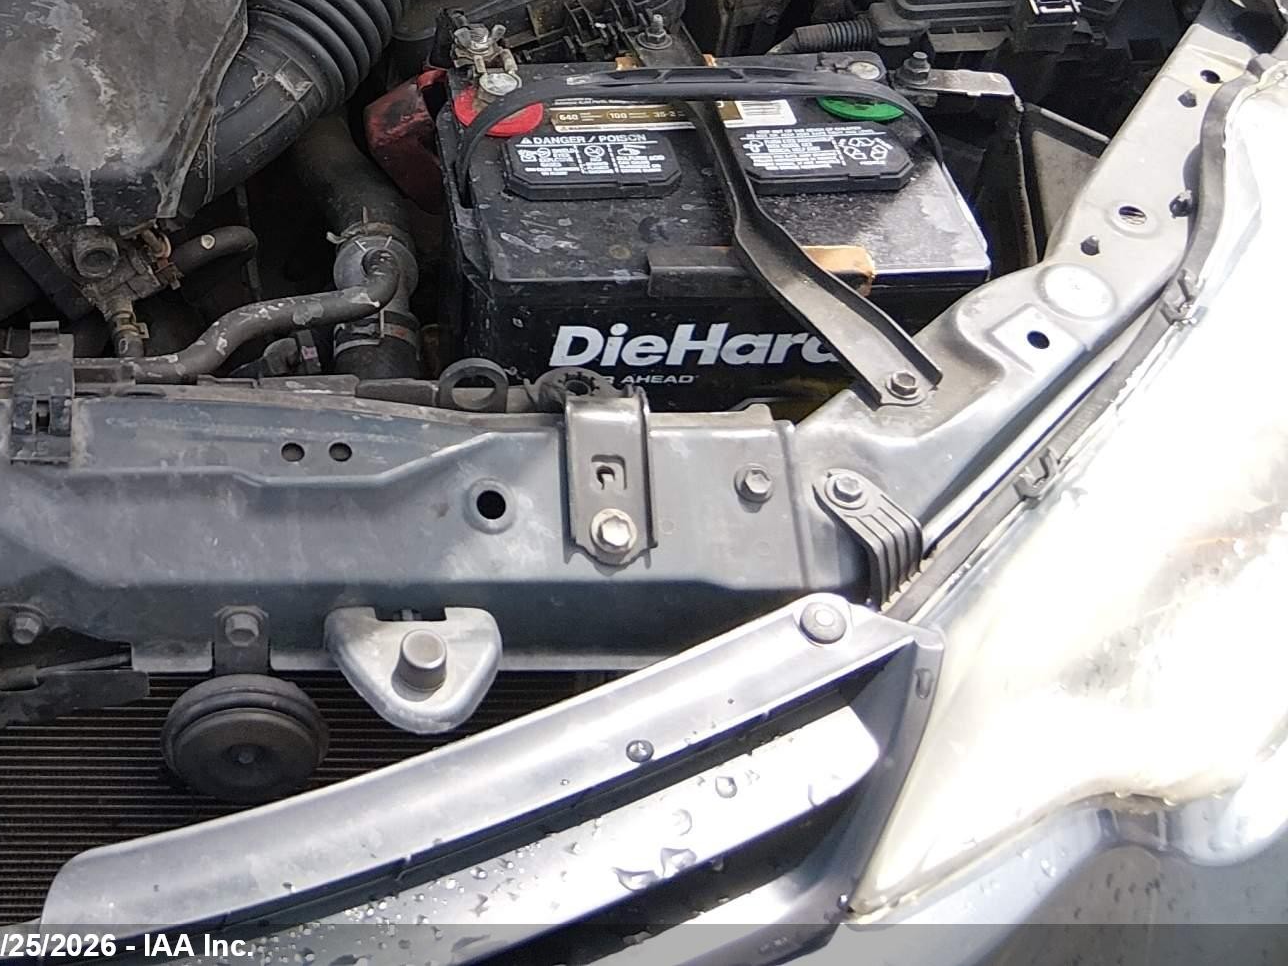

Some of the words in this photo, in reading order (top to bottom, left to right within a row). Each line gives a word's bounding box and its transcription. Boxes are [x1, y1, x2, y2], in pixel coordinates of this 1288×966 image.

[533, 136, 585, 144] DANGER
[599, 134, 647, 142] POISON
[620, 374, 696, 385] AHEAD
